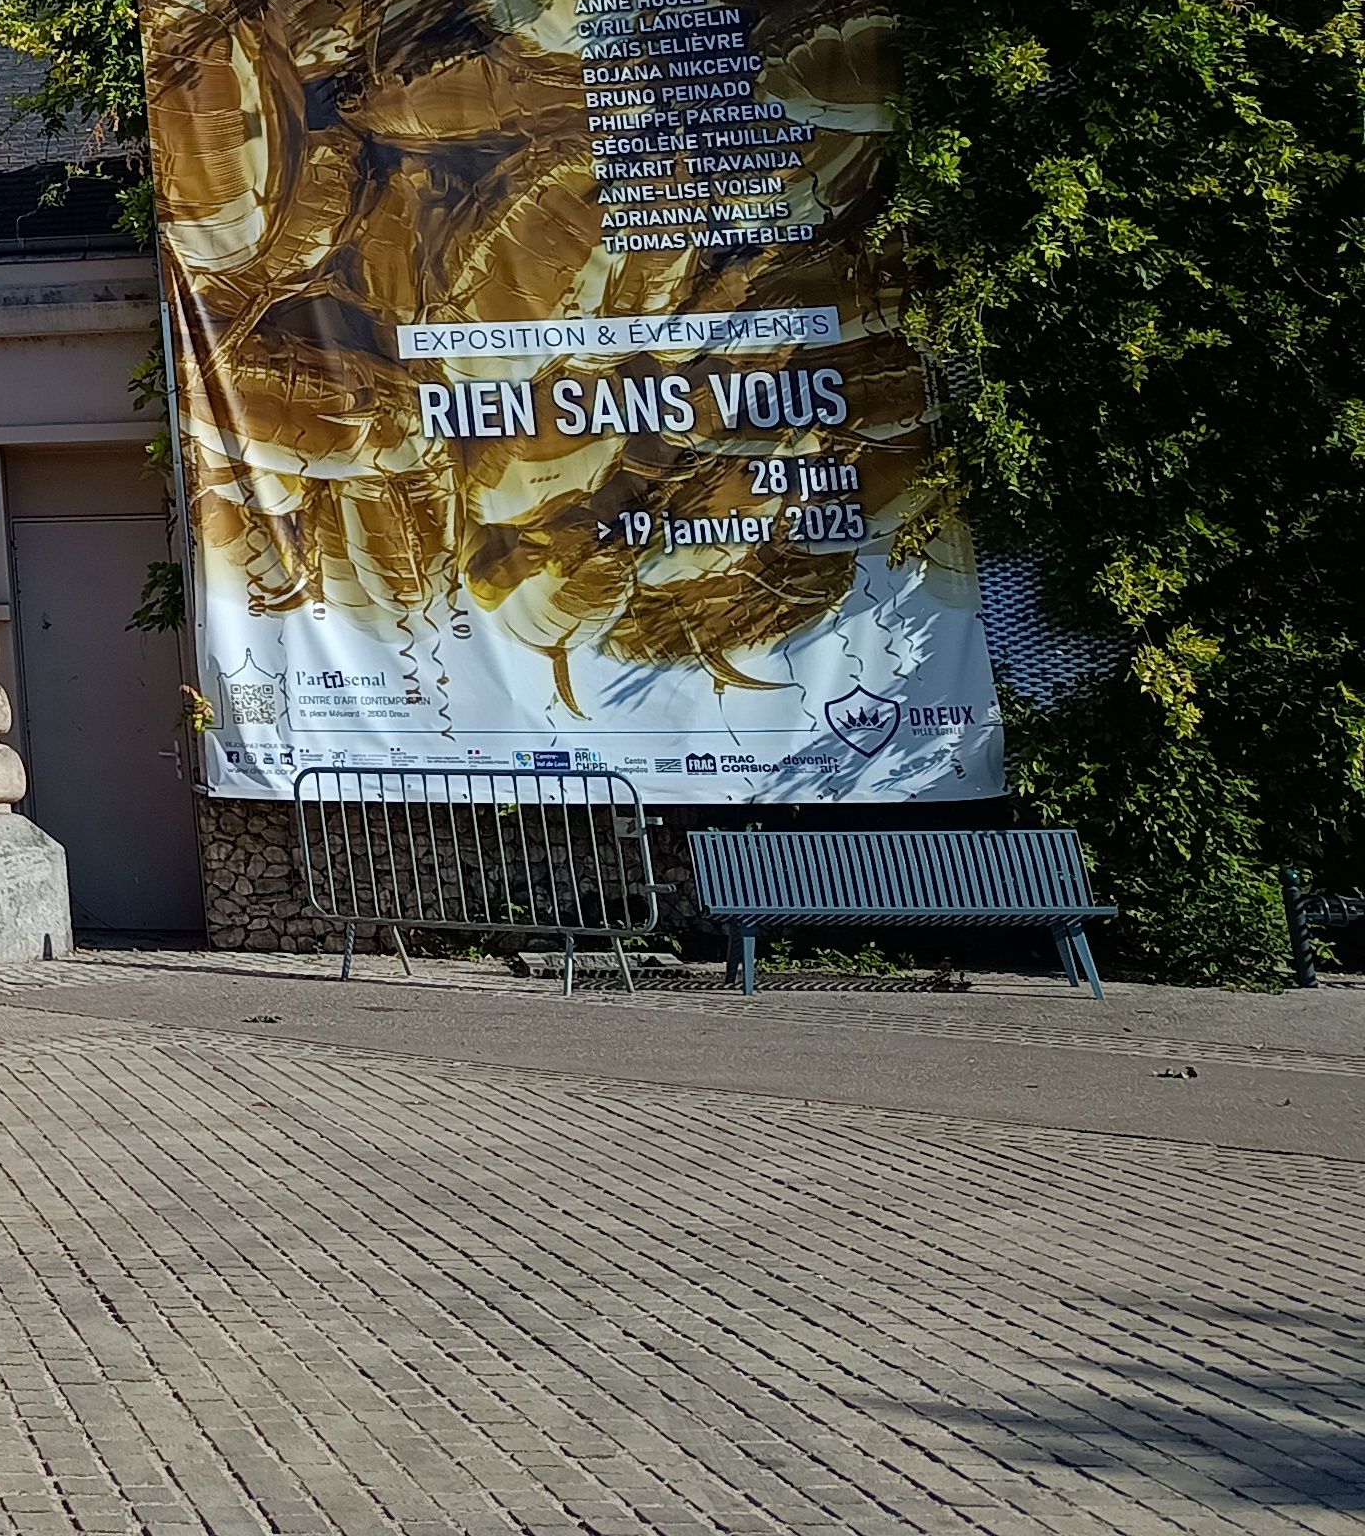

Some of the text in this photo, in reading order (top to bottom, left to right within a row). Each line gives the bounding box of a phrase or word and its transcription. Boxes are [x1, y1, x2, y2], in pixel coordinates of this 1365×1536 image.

[577, 8, 740, 37] CYRIL LANCELIN
[580, 31, 744, 61] ANAÏS LELIÈVRE
[583, 55, 762, 84] BOJANA NIKCEVIC
[585, 80, 751, 108] BRUNO PEINADO
[588, 102, 783, 132] PHILIPPE PARRENO
[591, 124, 815, 156] SÉGOLÈNE THUILLART
[593, 151, 802, 180] RIRKRIT TIRAVANIJA
[597, 176, 782, 204] ANNE-LISE VOISIN
[600, 201, 789, 229] ADRIANNA WALLIS
[601, 224, 814, 253] THOMAS WATTEBLED
[414, 313, 829, 352] EXPOSITION & ÉVÉNEMENTS
[418, 368, 848, 439] RIEN SANS VOUS
[748, 457, 860, 502] 28 juin
[619, 511, 652, 547] 19
[662, 509, 773, 554] janvier
[785, 502, 865, 541] 2025
[298, 696, 331, 705] CENTRE
[909, 705, 976, 726] DREUX
[688, 759, 715, 771] FRAC
[720, 755, 755, 764] FRAC
[721, 764, 780, 773] CORSICA
